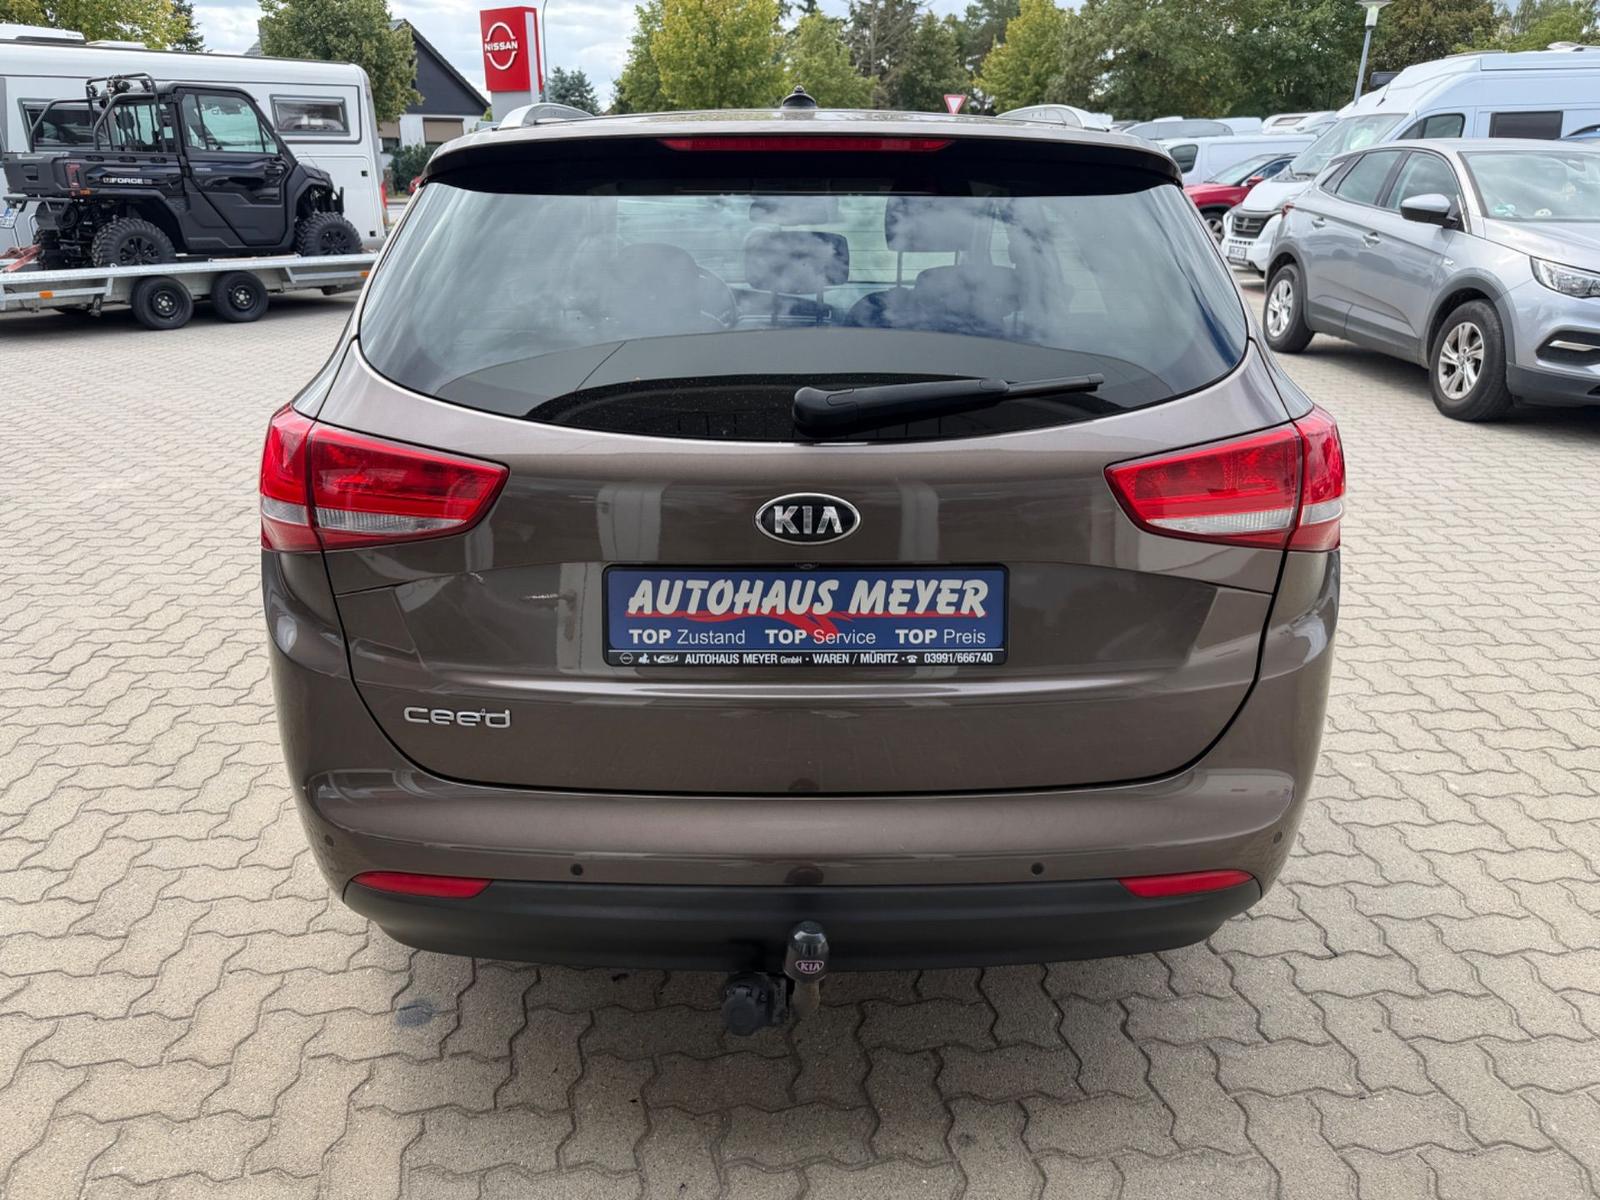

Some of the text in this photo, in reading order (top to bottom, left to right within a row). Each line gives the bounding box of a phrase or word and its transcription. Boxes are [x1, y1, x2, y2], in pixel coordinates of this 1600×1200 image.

[484, 40, 518, 52] NISSAN
[773, 505, 843, 534] KIA
[628, 579, 989, 618] AUTOHAUS MEYER
[628, 628, 986, 645] TOP Zustand TOP Service TOP Preis
[685, 653, 740, 664] AUTOHAUS
[743, 653, 778, 664] MEYER
[780, 656, 802, 665] GmbH
[812, 653, 850, 664] WAREN
[860, 651, 899, 664] MÜRITZ
[924, 652, 993, 664] 03991/666740
[403, 706, 511, 729] cee'd
[800, 962, 820, 971] KIA
